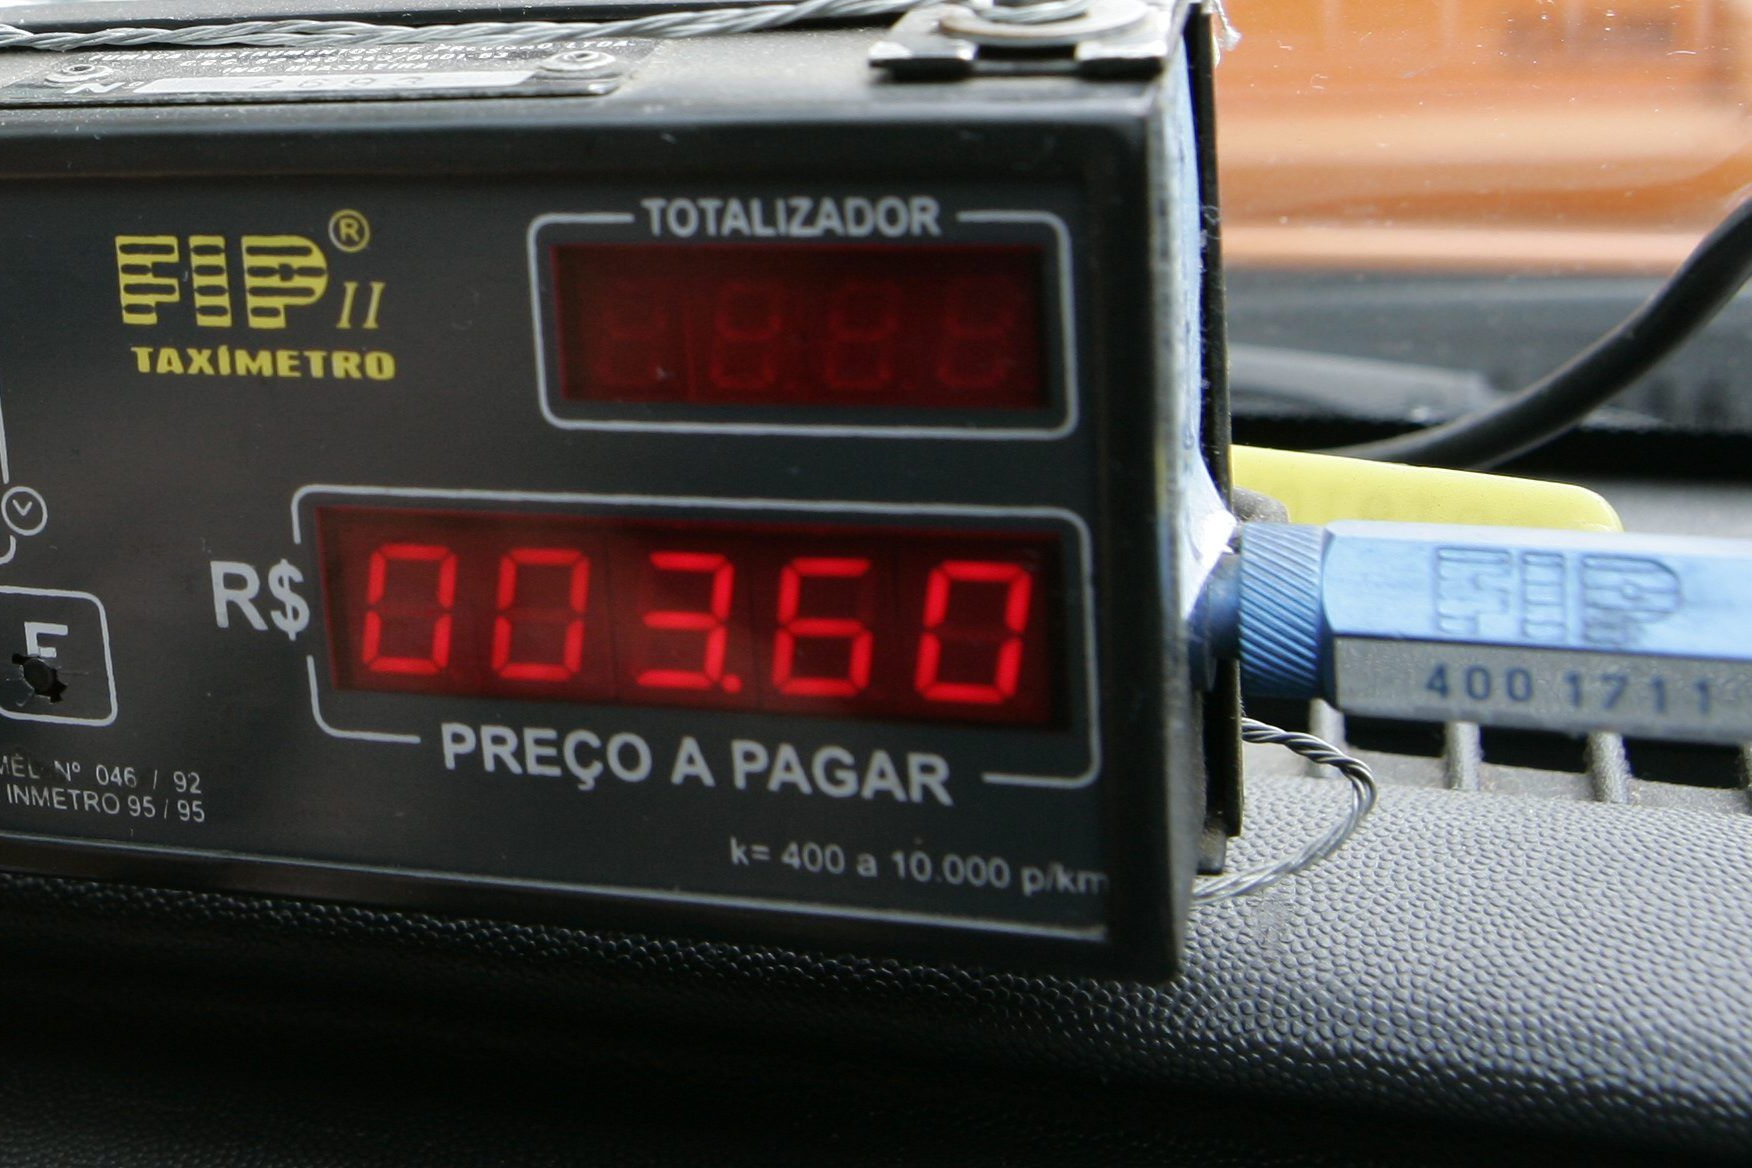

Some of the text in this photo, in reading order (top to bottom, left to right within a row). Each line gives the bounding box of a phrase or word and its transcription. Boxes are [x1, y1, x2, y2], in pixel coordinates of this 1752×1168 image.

[641, 195, 943, 238] TOTALIZADOR
[114, 234, 330, 330] FIP
[130, 344, 397, 381] TAXÍMETRO
[209, 559, 312, 642] R$
[95, 764, 137, 789] 046
[173, 771, 203, 795] 92
[439, 720, 954, 806] PREÇO A PAGAR
[5, 783, 120, 816] INMETRO
[127, 795, 157, 819] 95
[177, 799, 206, 823] 95
[781, 840, 846, 876] 400
[856, 851, 878, 879] a
[891, 848, 1012, 892] 10.000
